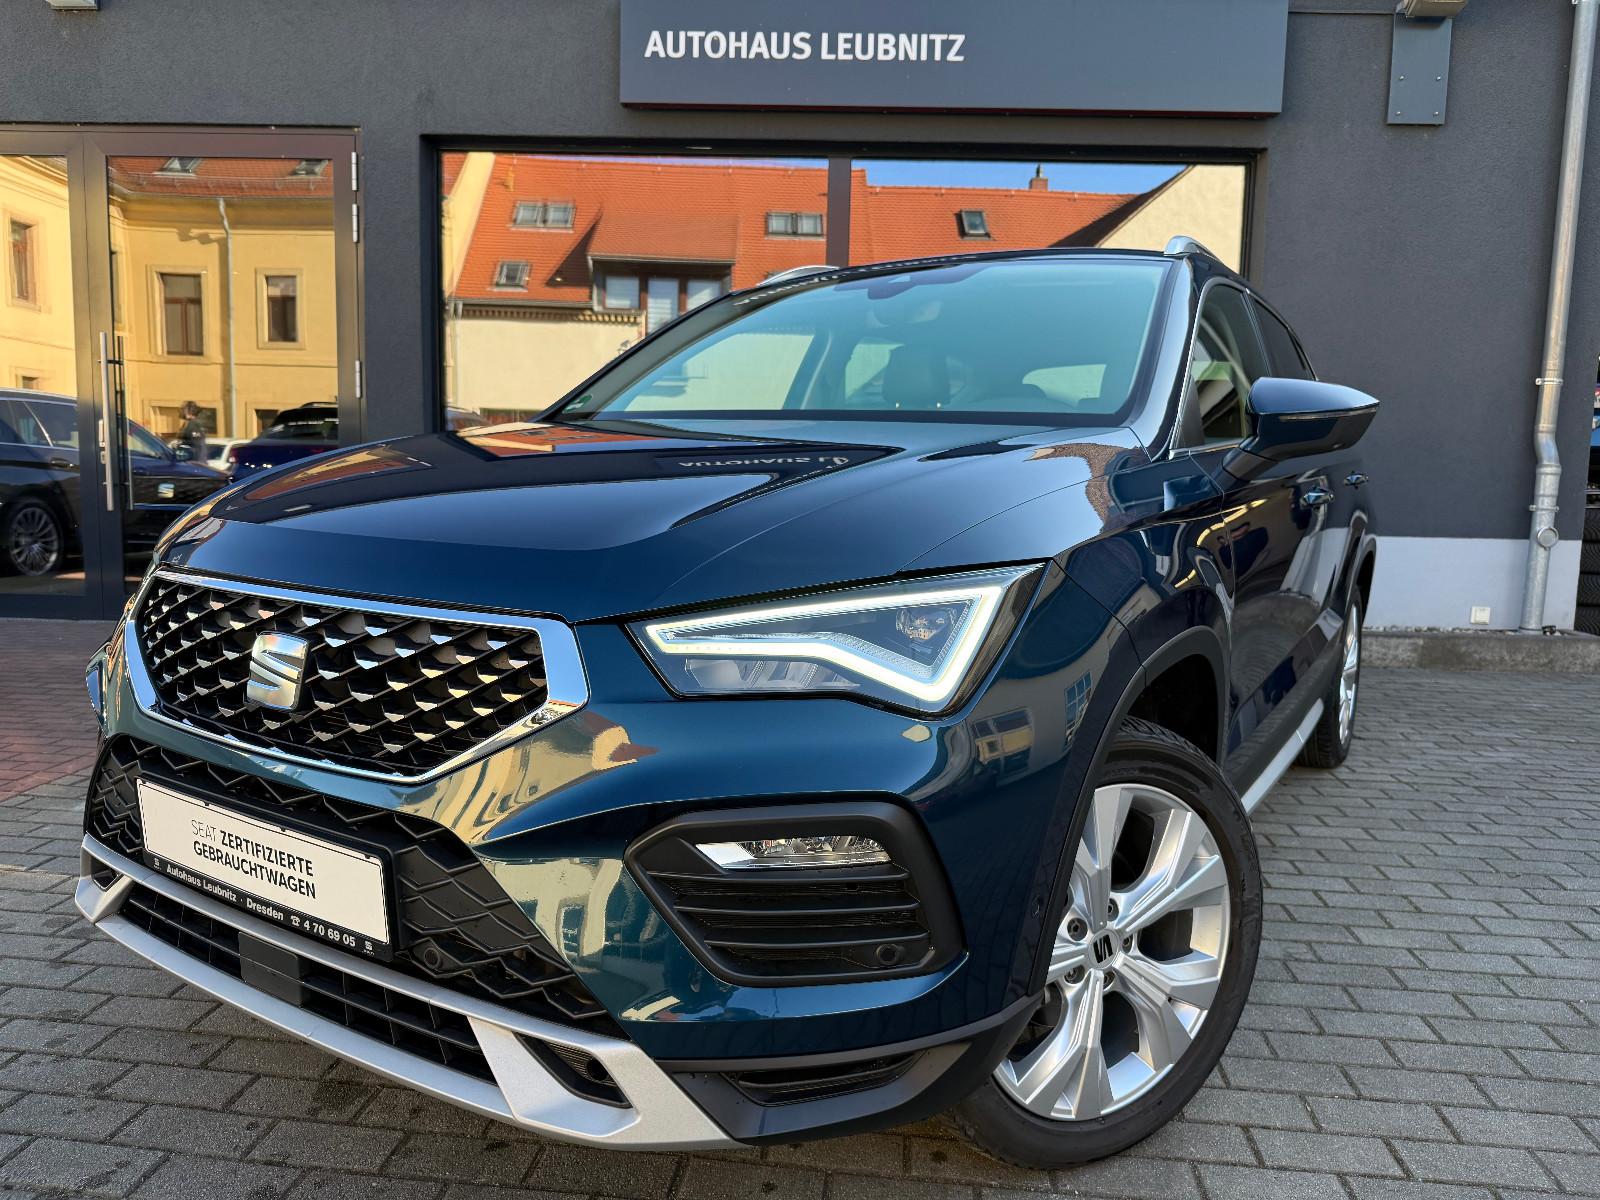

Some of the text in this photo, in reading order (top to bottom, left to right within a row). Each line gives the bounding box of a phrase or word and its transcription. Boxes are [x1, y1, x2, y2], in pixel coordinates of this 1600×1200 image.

[644, 30, 966, 62] AUTOHAUS LEUBNITZ
[191, 819, 314, 877] SEAT ZERTIFIZIERTE
[193, 841, 316, 899] GEBRAUCHTWAGEN
[166, 864, 356, 947] Autohaus Leubnitz Dresden 4 70 69 05
